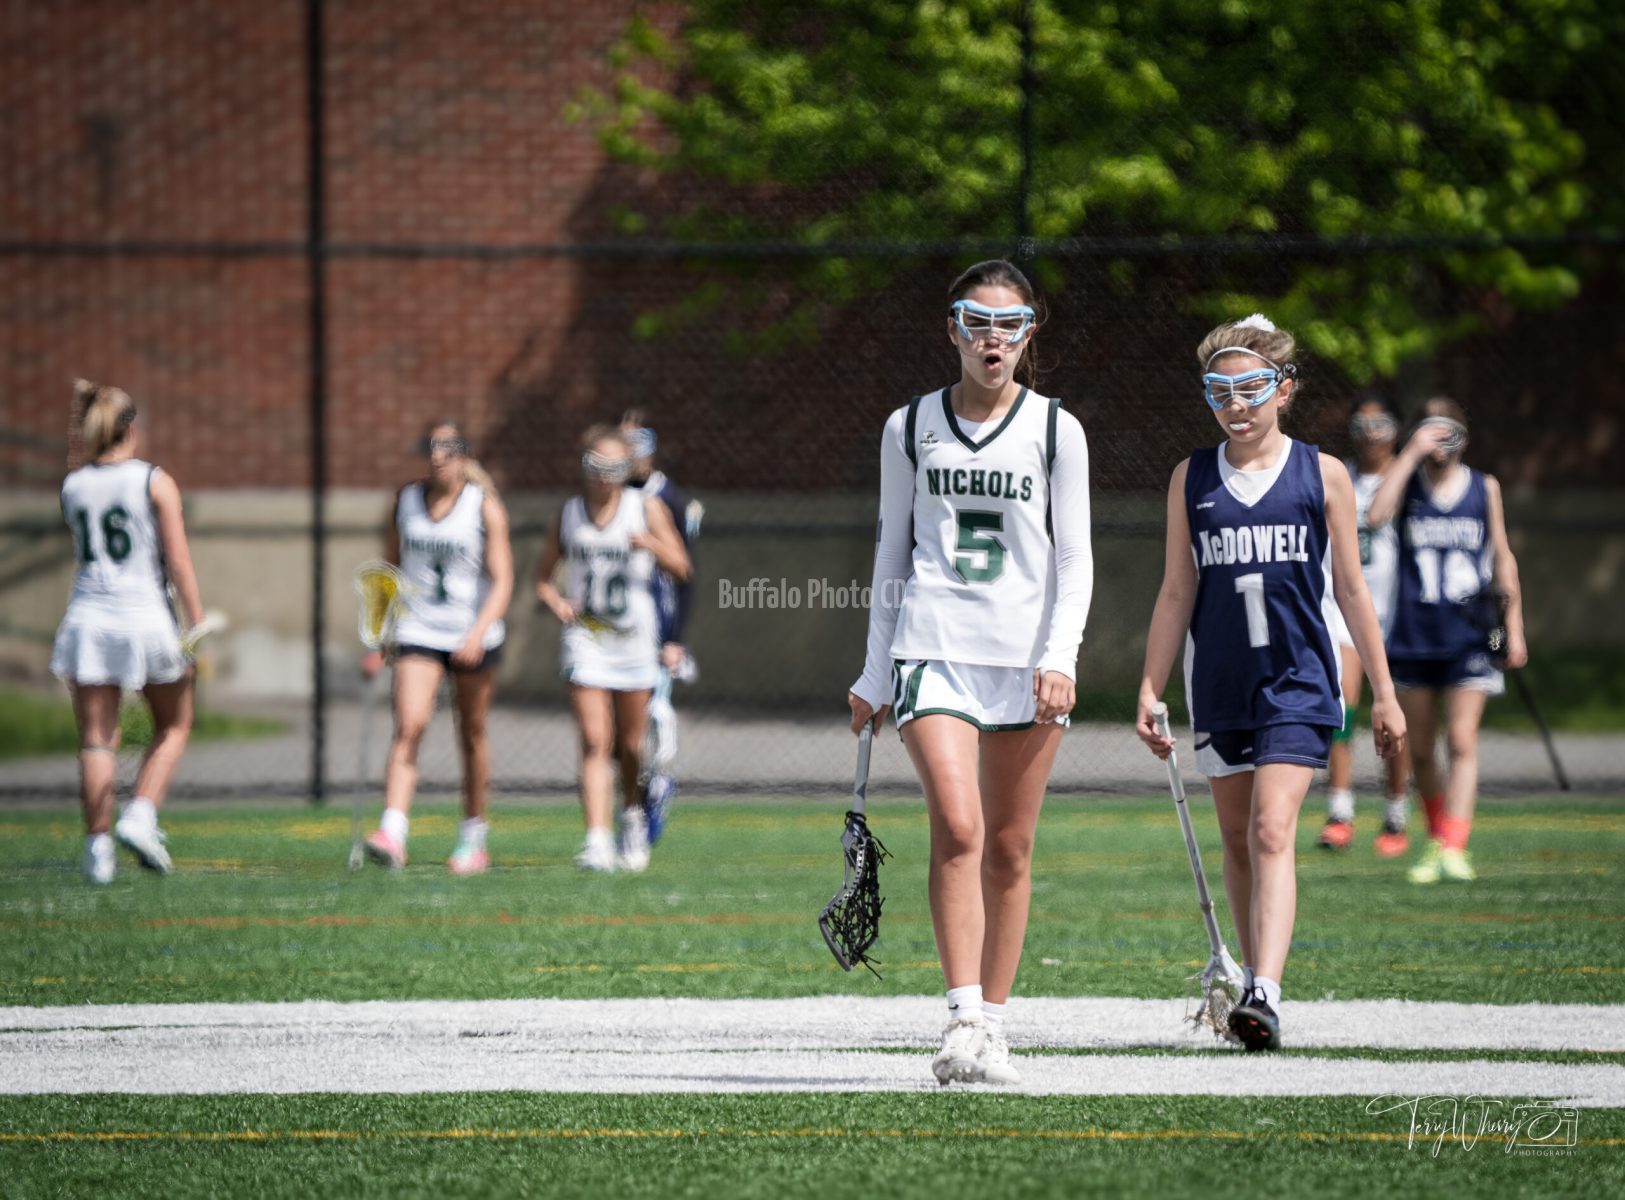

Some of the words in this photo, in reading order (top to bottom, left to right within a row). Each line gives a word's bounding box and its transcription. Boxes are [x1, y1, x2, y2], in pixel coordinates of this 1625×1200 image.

[927, 468, 1033, 502] NICHOLS
[76, 505, 132, 563] 16
[953, 508, 1007, 585] 5
[1198, 525, 1309, 566] McDOWELL
[1234, 572, 1271, 648] 1
